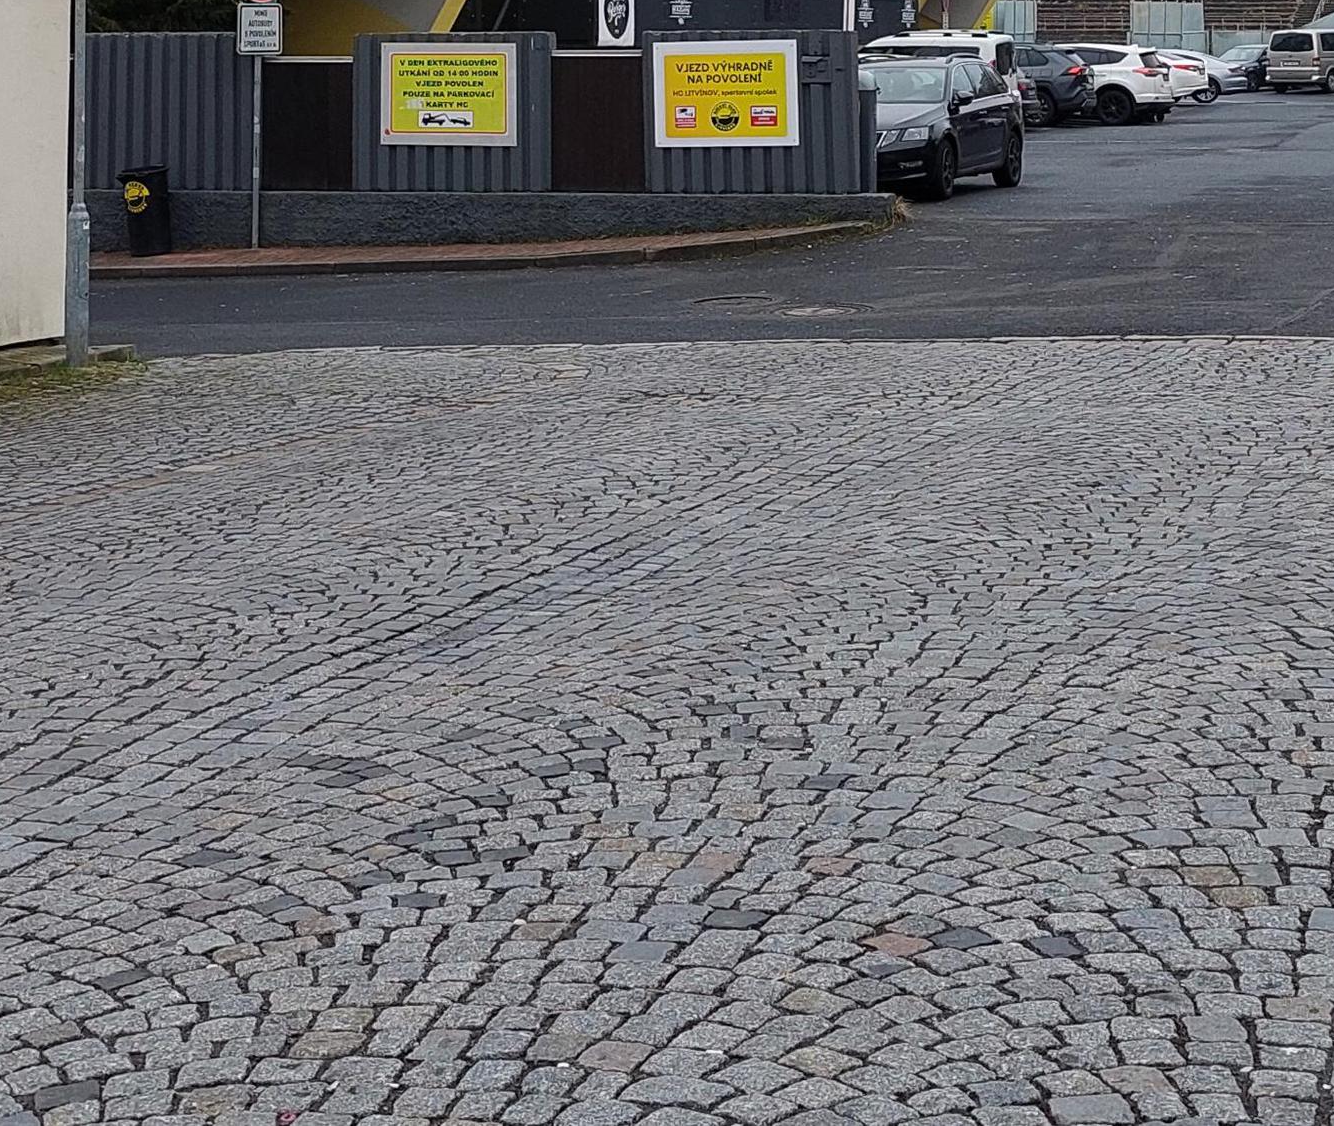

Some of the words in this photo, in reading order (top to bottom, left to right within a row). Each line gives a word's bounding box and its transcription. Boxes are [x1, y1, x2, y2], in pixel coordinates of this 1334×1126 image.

[427, 58, 498, 66] EXTRALIGOVÉHO
[675, 62, 709, 73] VJEZD
[712, 60, 773, 72] VÝHRADNĚ
[398, 69, 431, 77] UTKÁNÍ
[687, 75, 703, 84] NA
[706, 73, 762, 84] POVOLENÍ
[447, 90, 495, 98] PARKOVACÍ
